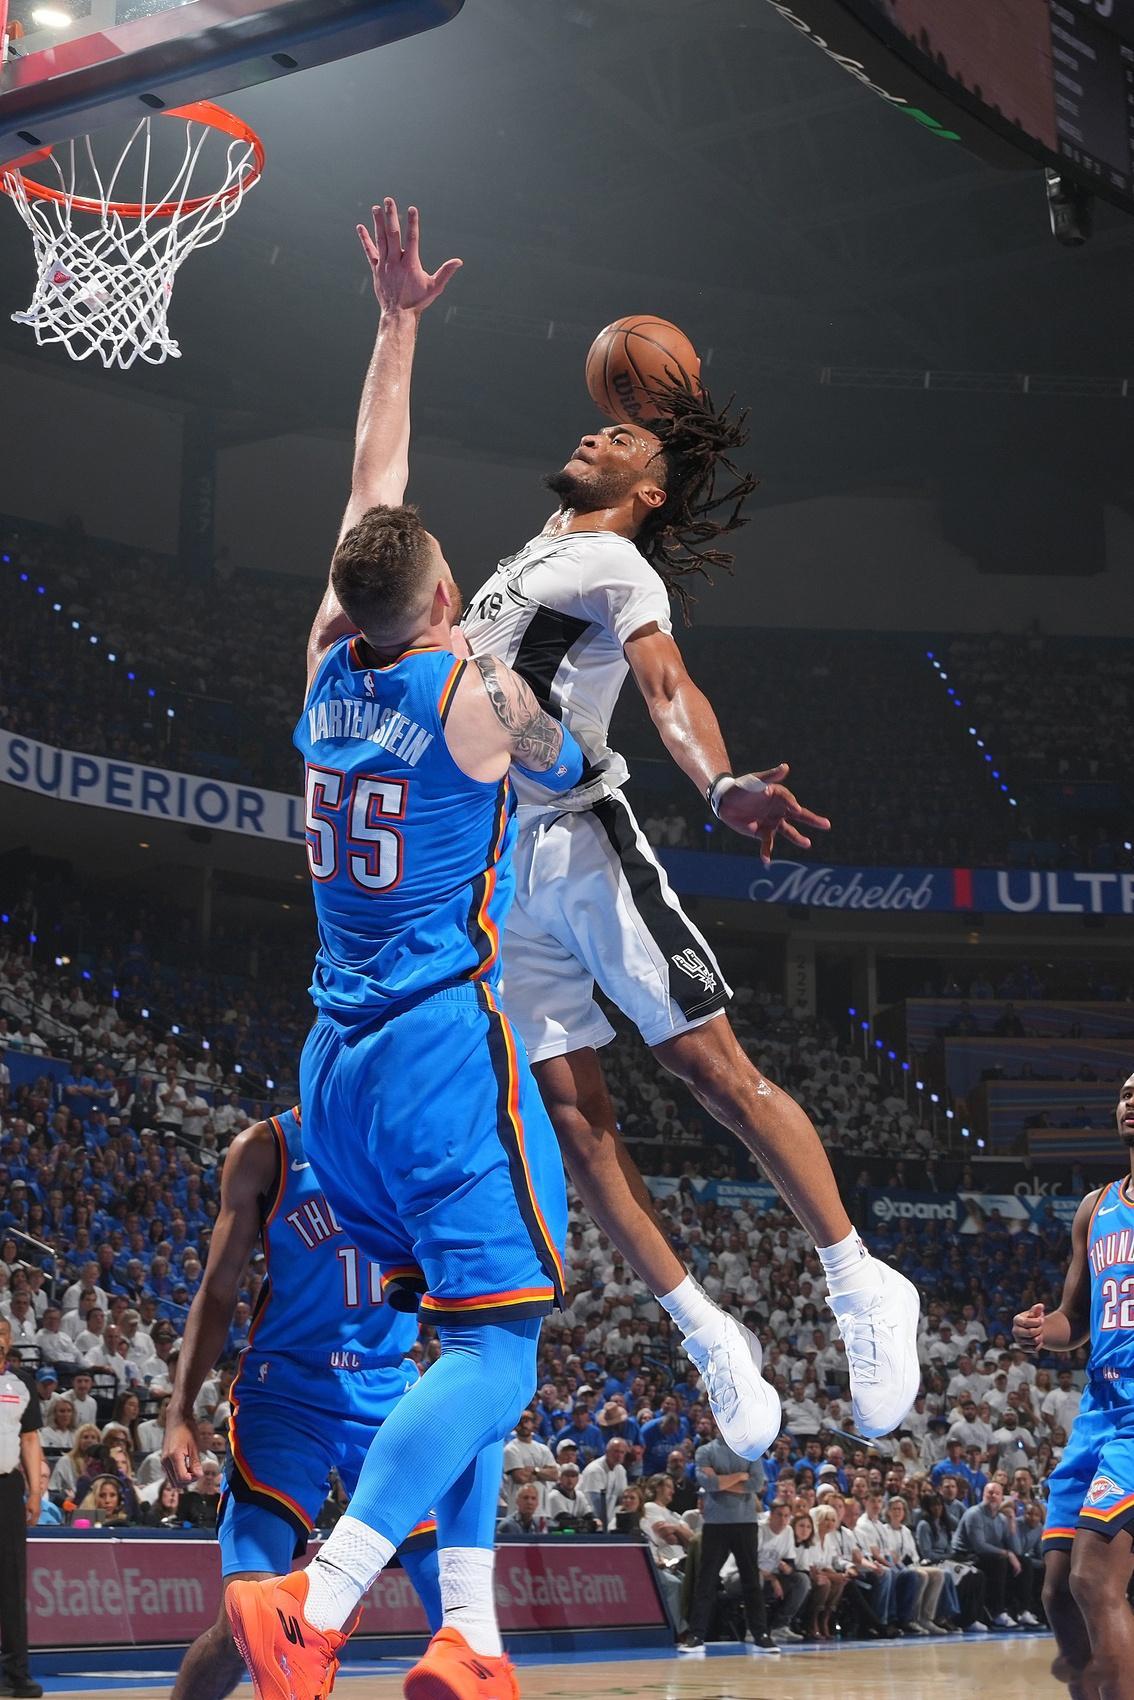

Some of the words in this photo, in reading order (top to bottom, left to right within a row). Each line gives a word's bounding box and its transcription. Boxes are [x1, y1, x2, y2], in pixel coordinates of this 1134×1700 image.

[308, 699, 434, 767] HARTENSTEIN
[6, 738, 265, 833] SUPERIOR
[305, 762, 408, 894] 55
[748, 860, 934, 910] Michelob
